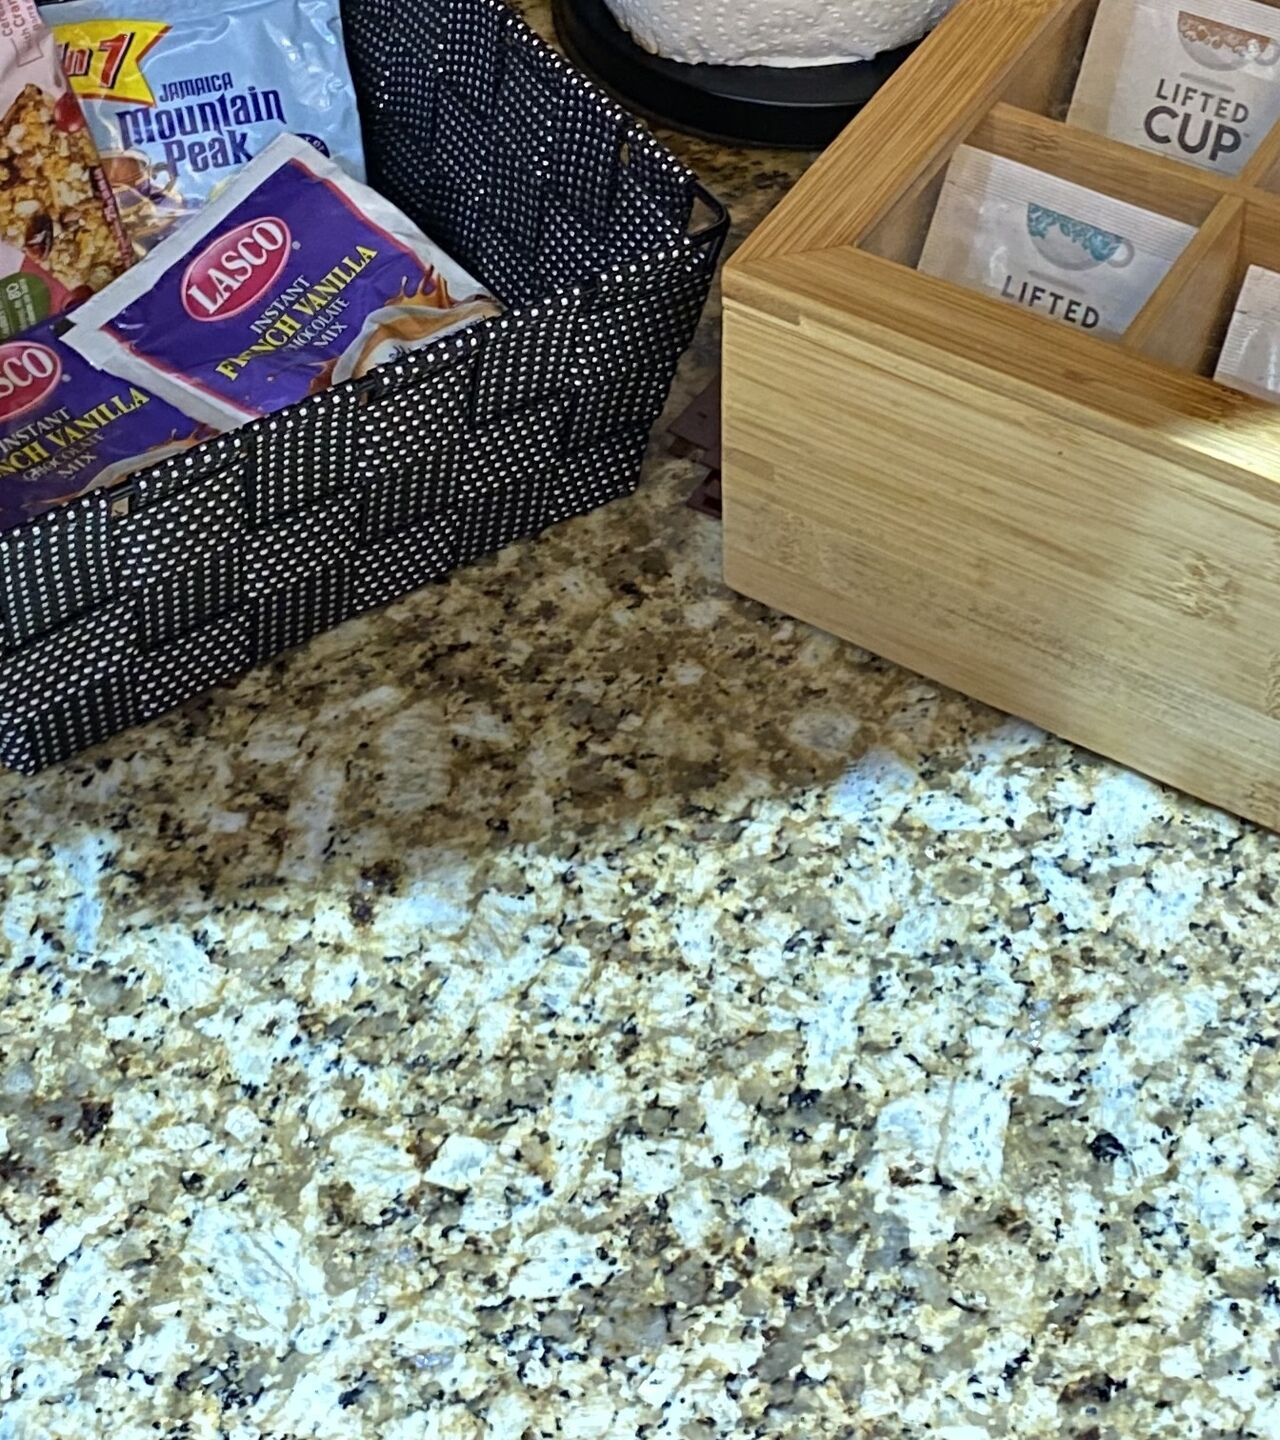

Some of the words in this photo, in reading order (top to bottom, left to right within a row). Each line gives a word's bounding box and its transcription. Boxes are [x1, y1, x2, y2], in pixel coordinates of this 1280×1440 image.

[99, 32, 136, 89] 1
[159, 72, 234, 102] JAMAICA
[114, 86, 287, 152] Mountain
[1155, 78, 1249, 123] LIFTED
[162, 129, 254, 180] Peak
[1144, 105, 1242, 162] CUP
[187, 221, 284, 314] LASCO
[293, 244, 379, 317] VANILLA
[249, 275, 312, 336] INSTANT
[287, 297, 350, 352] HOCOLATE
[1001, 275, 1100, 329] LIFTED
[313, 321, 349, 350] MIX
[46, 387, 150, 448] VANILLA
[57, 452, 97, 481] MIX
